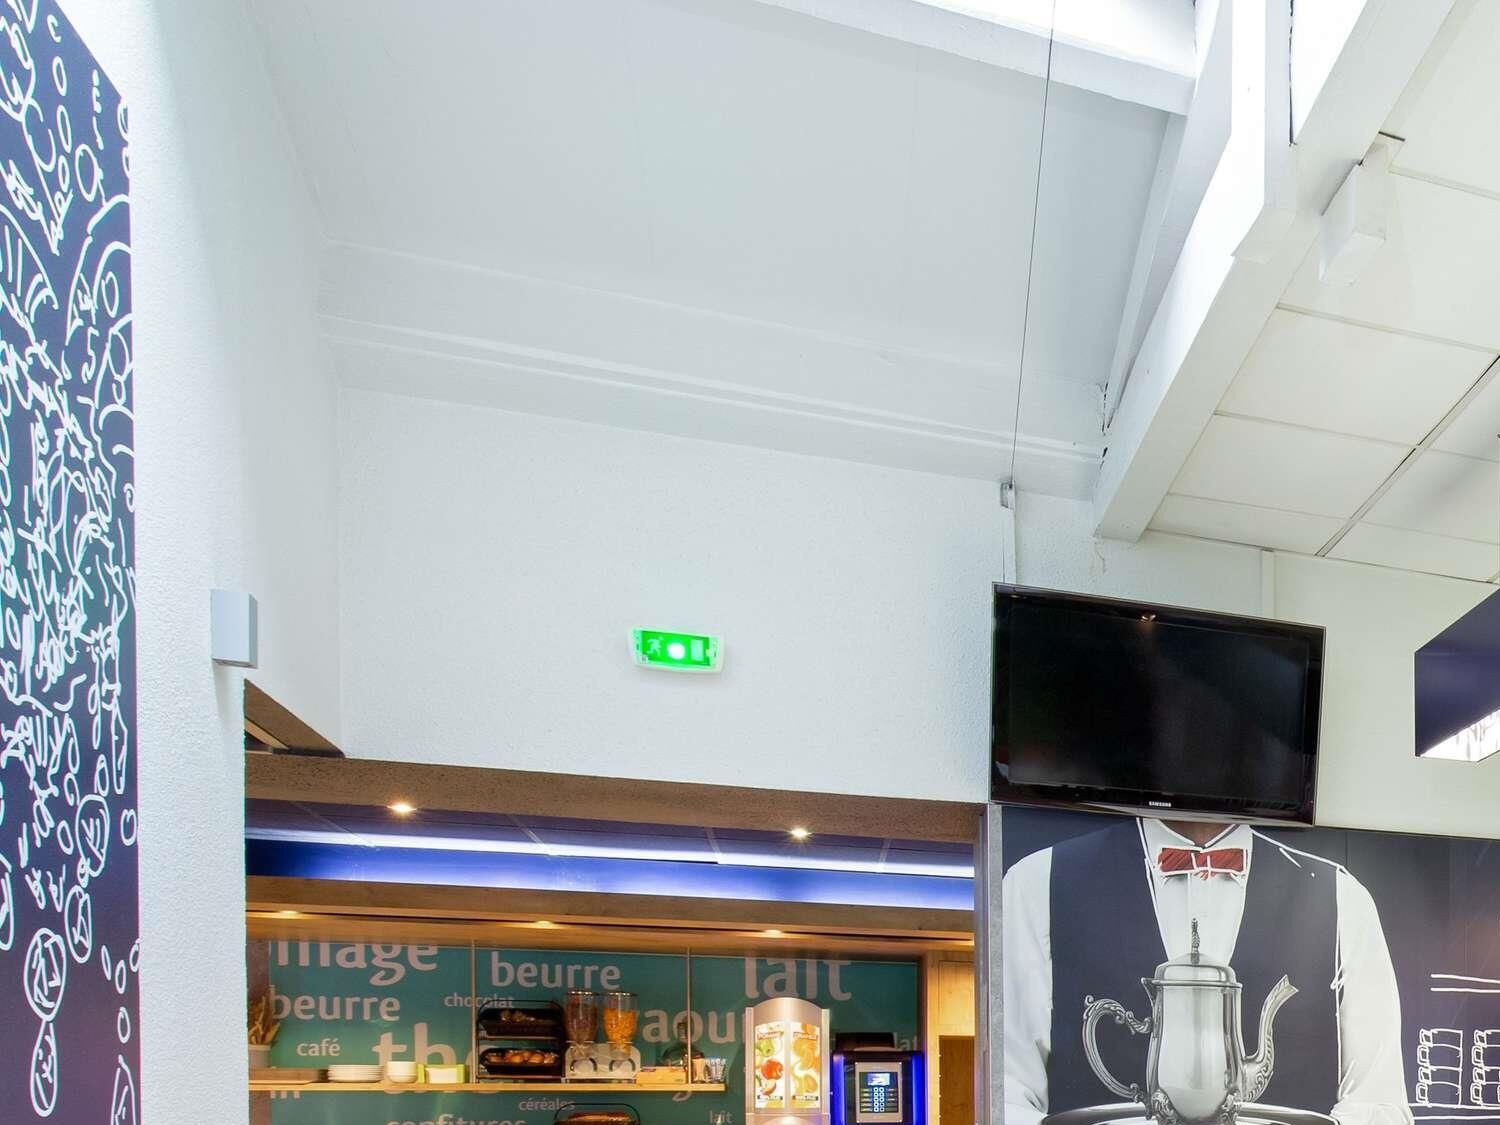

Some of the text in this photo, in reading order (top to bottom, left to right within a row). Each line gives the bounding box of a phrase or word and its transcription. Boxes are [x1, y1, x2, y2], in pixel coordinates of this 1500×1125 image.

[490, 951, 621, 990] beurre
[744, 956, 852, 1000] lait
[269, 985, 401, 1021] beurre
[443, 991, 515, 1008] chocolat
[296, 1038, 342, 1057] café
[517, 1097, 576, 1111] céréales
[708, 1110, 733, 1124] lait
